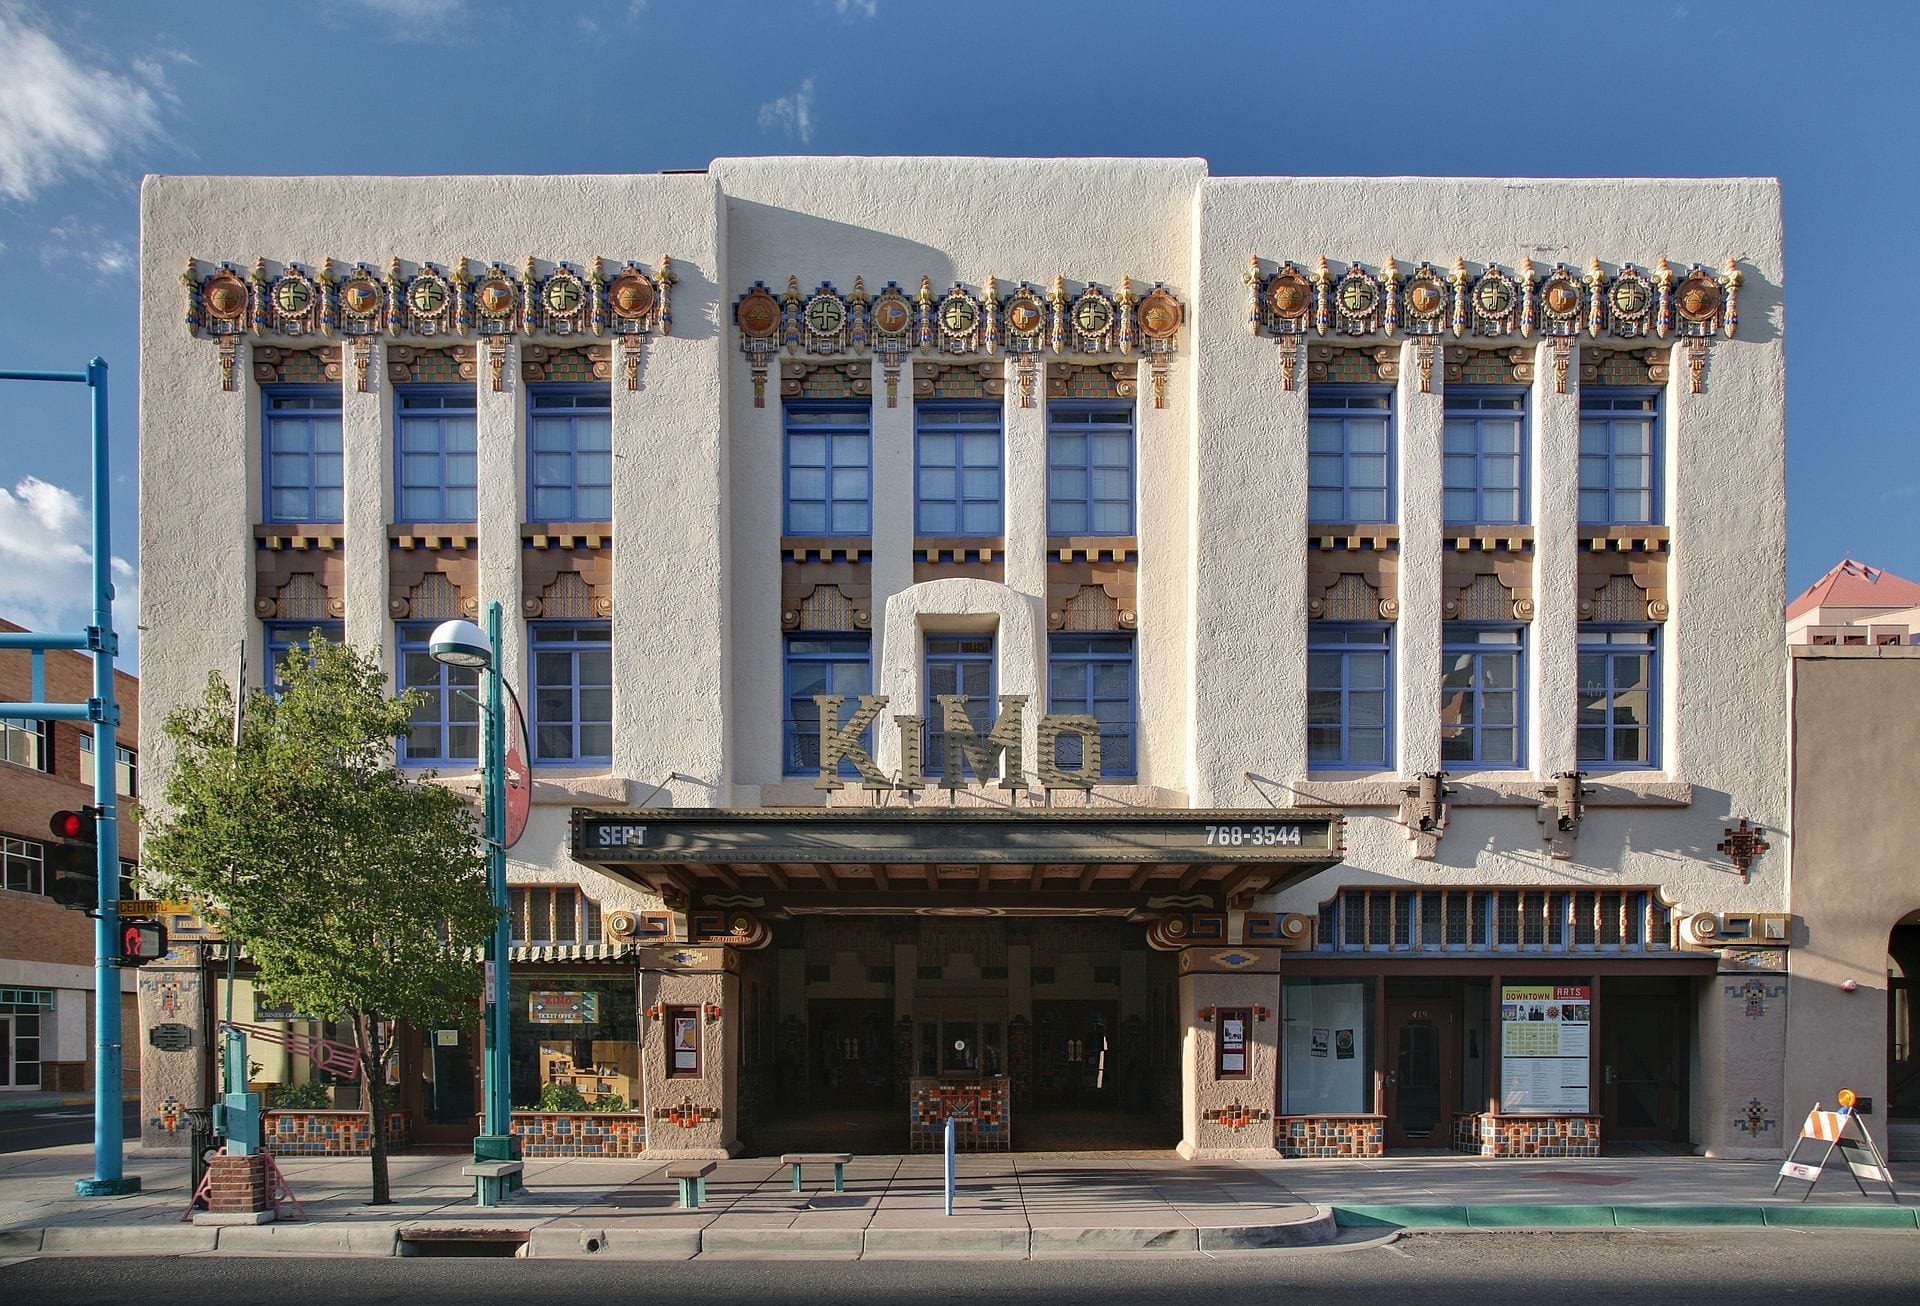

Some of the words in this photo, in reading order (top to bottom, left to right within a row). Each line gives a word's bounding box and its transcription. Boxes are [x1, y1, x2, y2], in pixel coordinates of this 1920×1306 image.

[599, 826, 647, 845] SEPT
[1205, 826, 1301, 845] 768-3544
[120, 902, 167, 912] CENTRAL
[1557, 988, 1581, 996] ARTS
